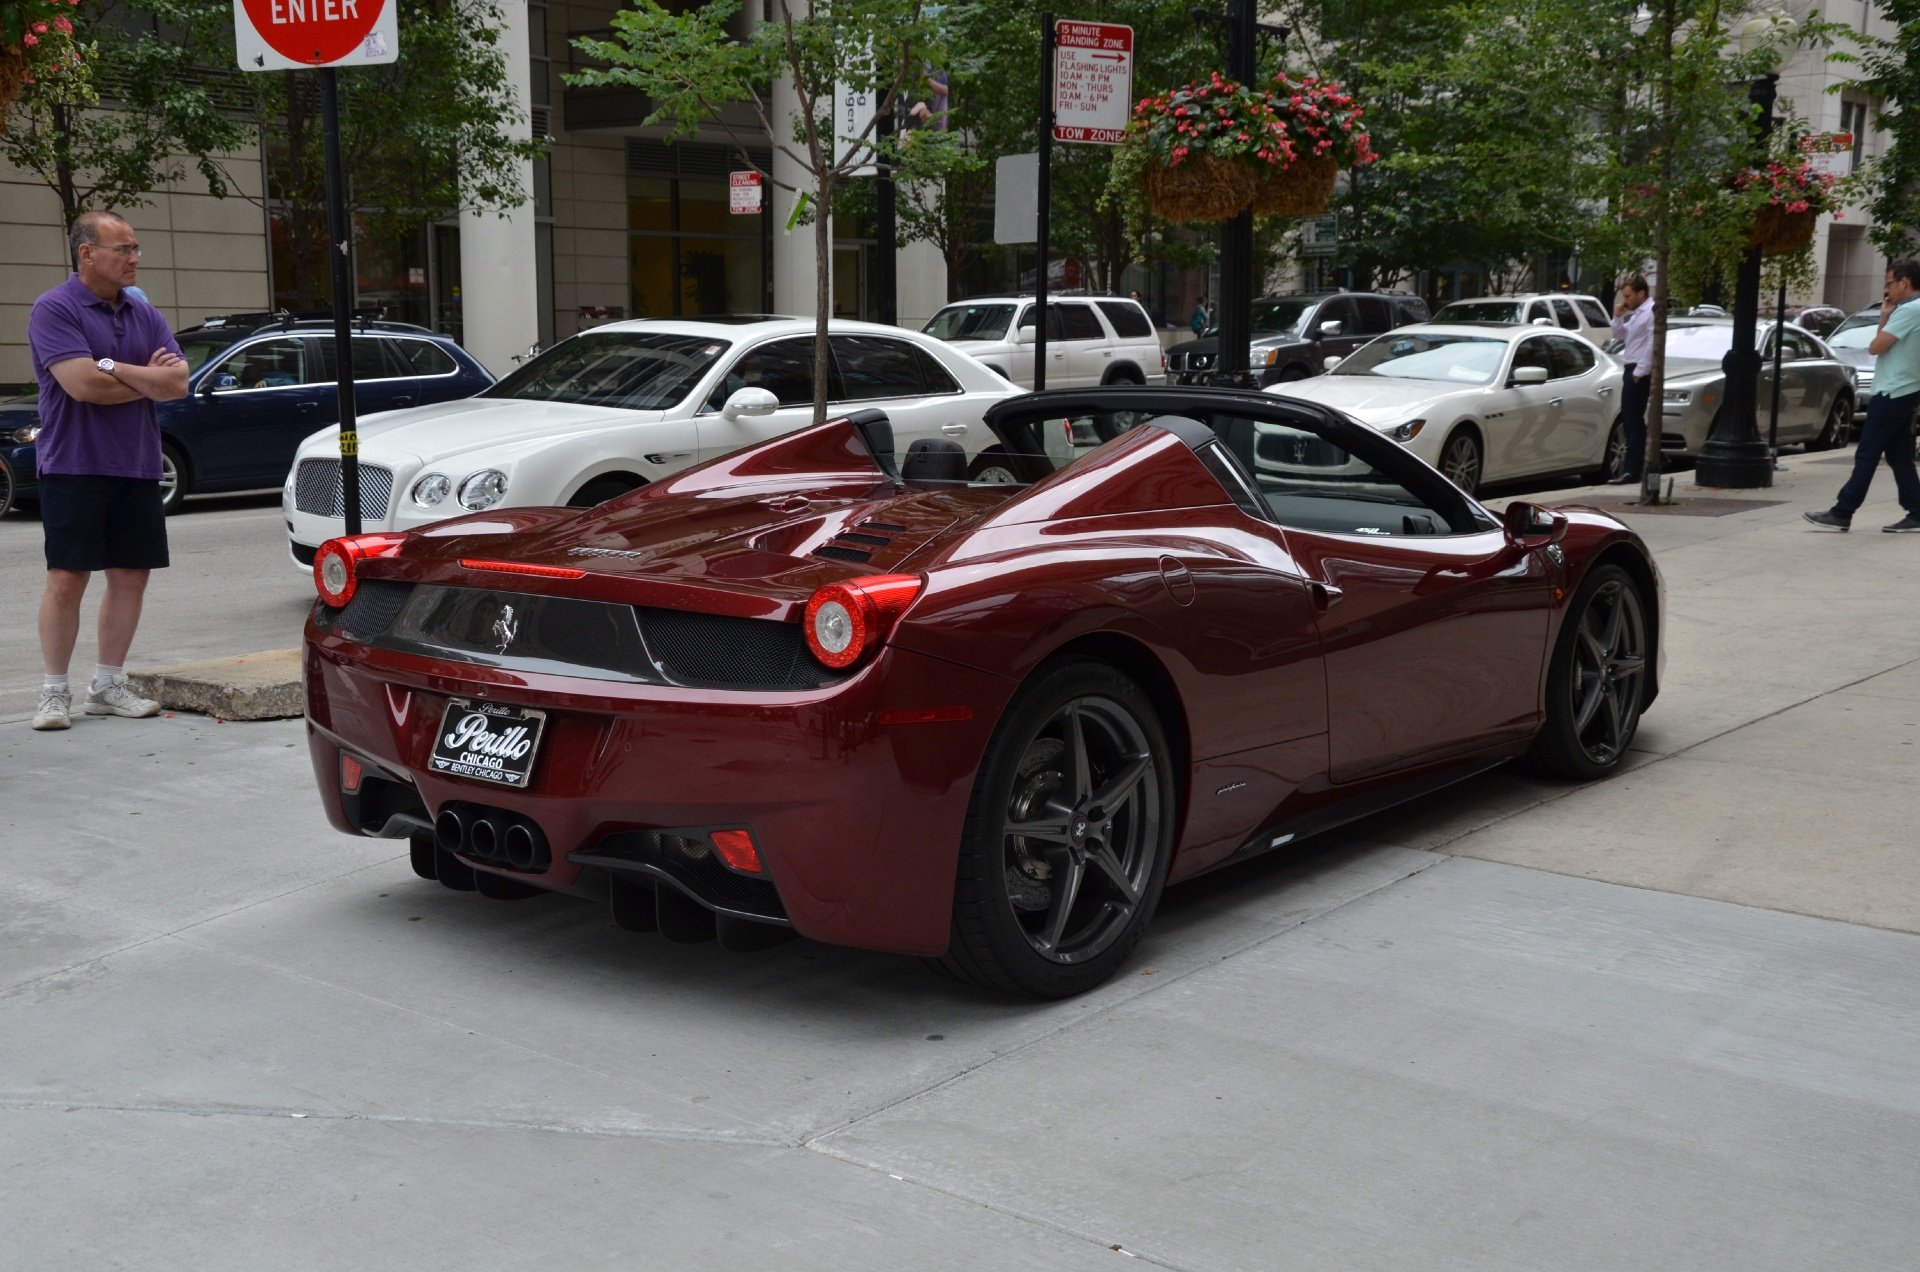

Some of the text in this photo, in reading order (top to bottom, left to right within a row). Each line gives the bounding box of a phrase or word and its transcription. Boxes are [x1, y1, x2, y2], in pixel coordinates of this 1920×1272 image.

[271, 0, 359, 24] ENTER
[1061, 25, 1101, 37] 15 MINUTE
[1061, 35, 1124, 49] STANDING ZONE
[1060, 51, 1076, 60] USE
[1060, 61, 1127, 75] FLASHING LIGHTS
[1060, 71, 1069, 80] 10
[1070, 72, 1083, 80] AM
[1090, 73, 1096, 82] 8
[1098, 73, 1110, 83] PM
[1060, 81, 1078, 90] MON
[1087, 82, 1113, 93] THURS
[1060, 91, 1067, 99] 10
[1068, 92, 1082, 100] AM
[1089, 93, 1095, 102] 6
[1097, 94, 1109, 102] PM
[1060, 101, 1073, 110] FRI
[1080, 102, 1097, 112] SUN
[1058, 127, 1122, 142] TOW ZONE
[478, 702, 511, 716] Perillo
[444, 713, 531, 761] Perillo
[460, 751, 504, 769] CHICAGO
[451, 762, 503, 780] BENTLEY CHICAGO
